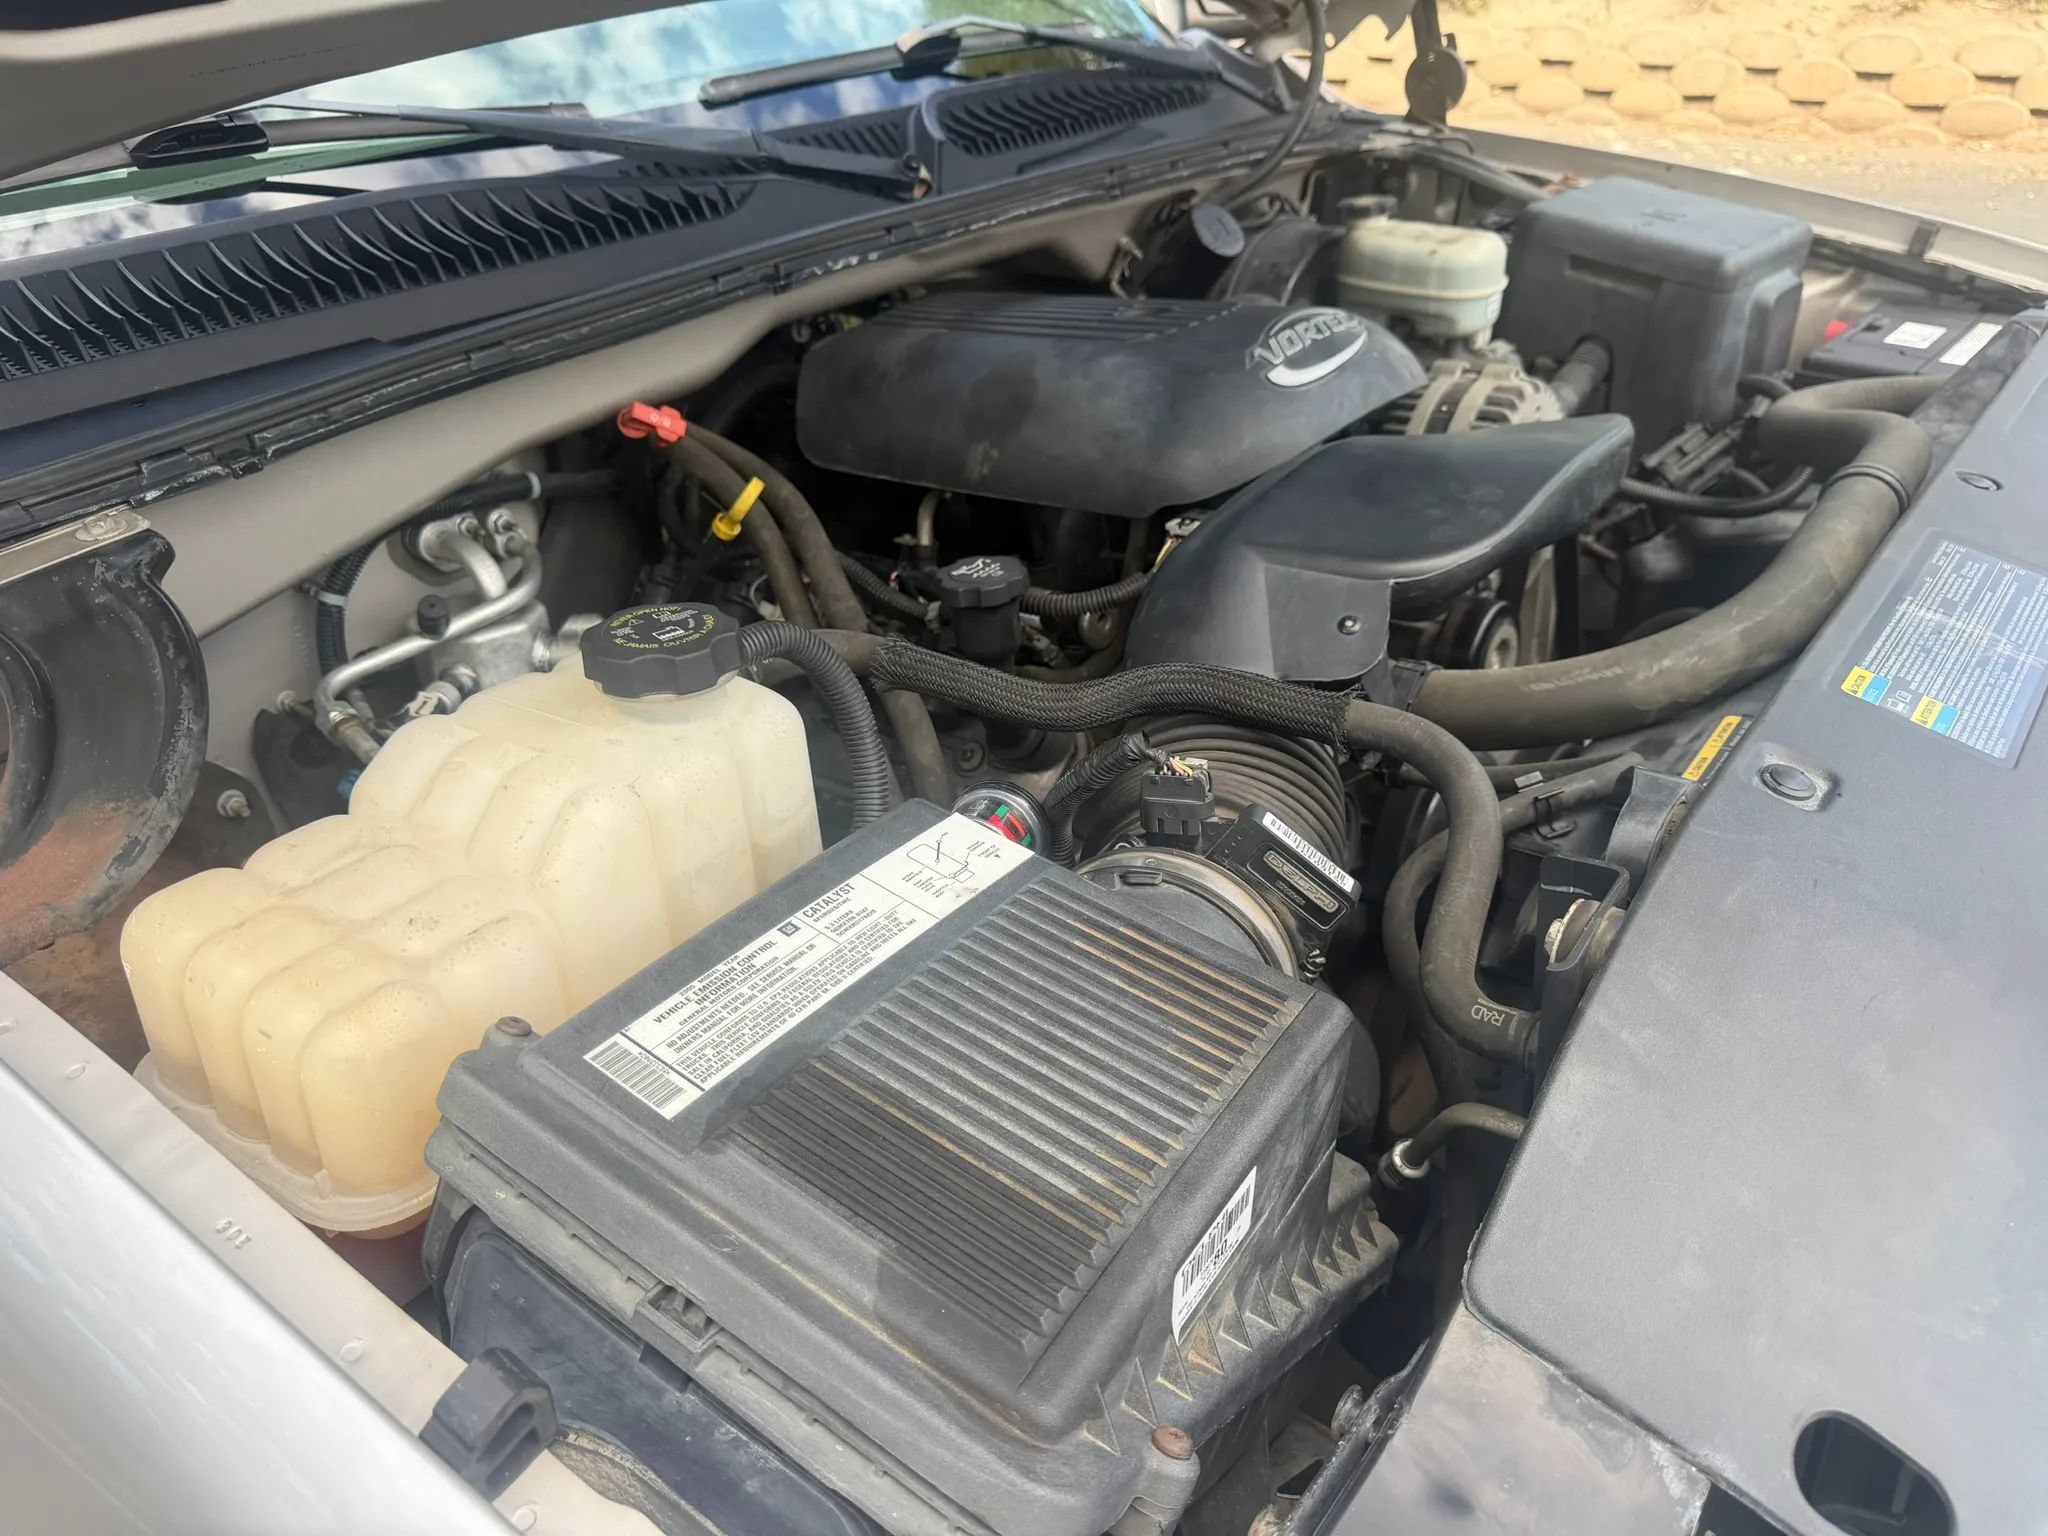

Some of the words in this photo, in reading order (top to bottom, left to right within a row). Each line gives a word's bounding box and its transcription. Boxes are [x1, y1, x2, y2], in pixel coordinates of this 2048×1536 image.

[633, 608, 658, 617] OPEN
[802, 883, 855, 918] CATALYST
[1265, 852, 1338, 911] DELPHI
[653, 995, 694, 1023] VEHICLE
[692, 966, 738, 997] EMISSION
[736, 940, 778, 967] CONTROL
[666, 1040, 678, 1048] NO
[676, 1008, 722, 1041] ADJUSTMENTS
[720, 992, 748, 1010] NEEDED.
[747, 982, 761, 991] SEE
[759, 965, 785, 983] SERVICE
[782, 950, 808, 967] MANUAL
[673, 1032, 703, 1054] OWNERS
[700, 1015, 728, 1034] MANUAL
[726, 1005, 742, 1016] FOR
[739, 993, 761, 1007] MORE
[756, 966, 799, 995] INFORMATION.
[676, 1056, 693, 1067] THIS
[690, 1038, 718, 1057] VEHICLE
[716, 1015, 750, 1039] CONFORMS
[757, 1001, 771, 1010] U.S.
[769, 992, 782, 1001] EPA
[780, 966, 819, 993] REGULATIONS
[817, 945, 848, 967] APPLICABLE
[854, 931, 868, 941] NEW
[678, 1005, 709, 1026] GENERAL
[708, 985, 737, 1005] MOTORS
[736, 956, 779, 986] CORPORATION
[682, 1052, 710, 1071] TRUCKS.
[710, 1039, 726, 1051] THIS
[724, 1022, 750, 1040] VEHICLE
[749, 1000, 781, 1023] CONFORMS
[788, 977, 814, 995] FEDERAL
[812, 952, 848, 978] REGULATIONS
[847, 944, 859, 954] AND
[864, 924, 889, 941] CERTIFIED
[887, 917, 900, 925] FOR
[687, 1063, 705, 1076] SALE
[712, 1032, 750, 1058] CALIFORNIA,
[748, 1021, 762, 1032] AND
[760, 1001, 791, 1023] QUALIFIES
[821, 968, 836, 978] THIS
[834, 954, 856, 970] VEHICLE
[860, 932, 887, 951] CERTIFIED
[892, 921, 904, 929] THE
[693, 1064, 715, 1080] CLEAN
[713, 1053, 731, 1065] FUEL
[729, 1039, 748, 1054] FLEET
[747, 1030, 760, 1040] LEV
[758, 1006, 794, 1032] STANDARDS
[791, 994, 811, 1008] WHEN
[809, 974, 838, 995] OPERATED
[845, 951, 870, 970] GASOLINE
[870, 943, 882, 952] AND
[880, 932, 898, 944] MEETS
[694, 963, 757, 1006] INFORMATION
[697, 968, 721, 984] MODEL
[723, 955, 740, 967] YEAR
[700, 1056, 737, 1084] APPLICABLE
[734, 1024, 780, 1058] REQUIREMENTS
[795, 1003, 808, 1013] CFR
[806, 993, 822, 1005] PART
[846, 956, 875, 976] CERTIFIED.
[1471, 1004, 1505, 1026] RAD
